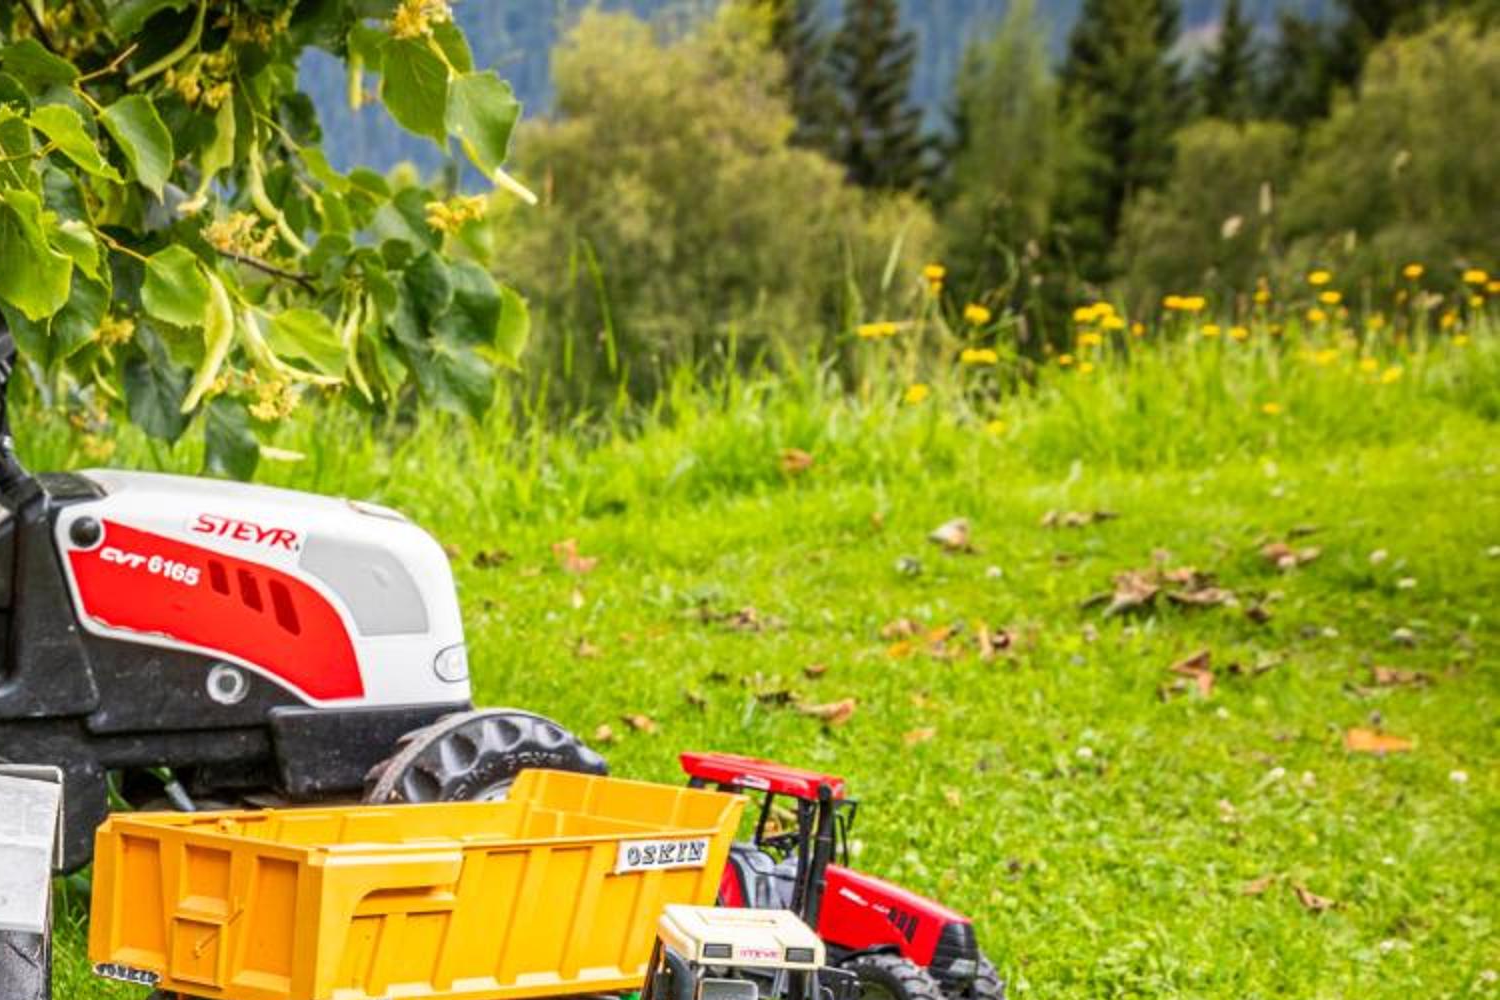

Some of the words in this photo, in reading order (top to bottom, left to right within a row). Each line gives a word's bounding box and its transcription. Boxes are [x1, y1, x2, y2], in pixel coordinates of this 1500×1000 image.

[192, 513, 297, 550] STEYR
[100, 546, 147, 569] CVT
[147, 555, 201, 586] 6165
